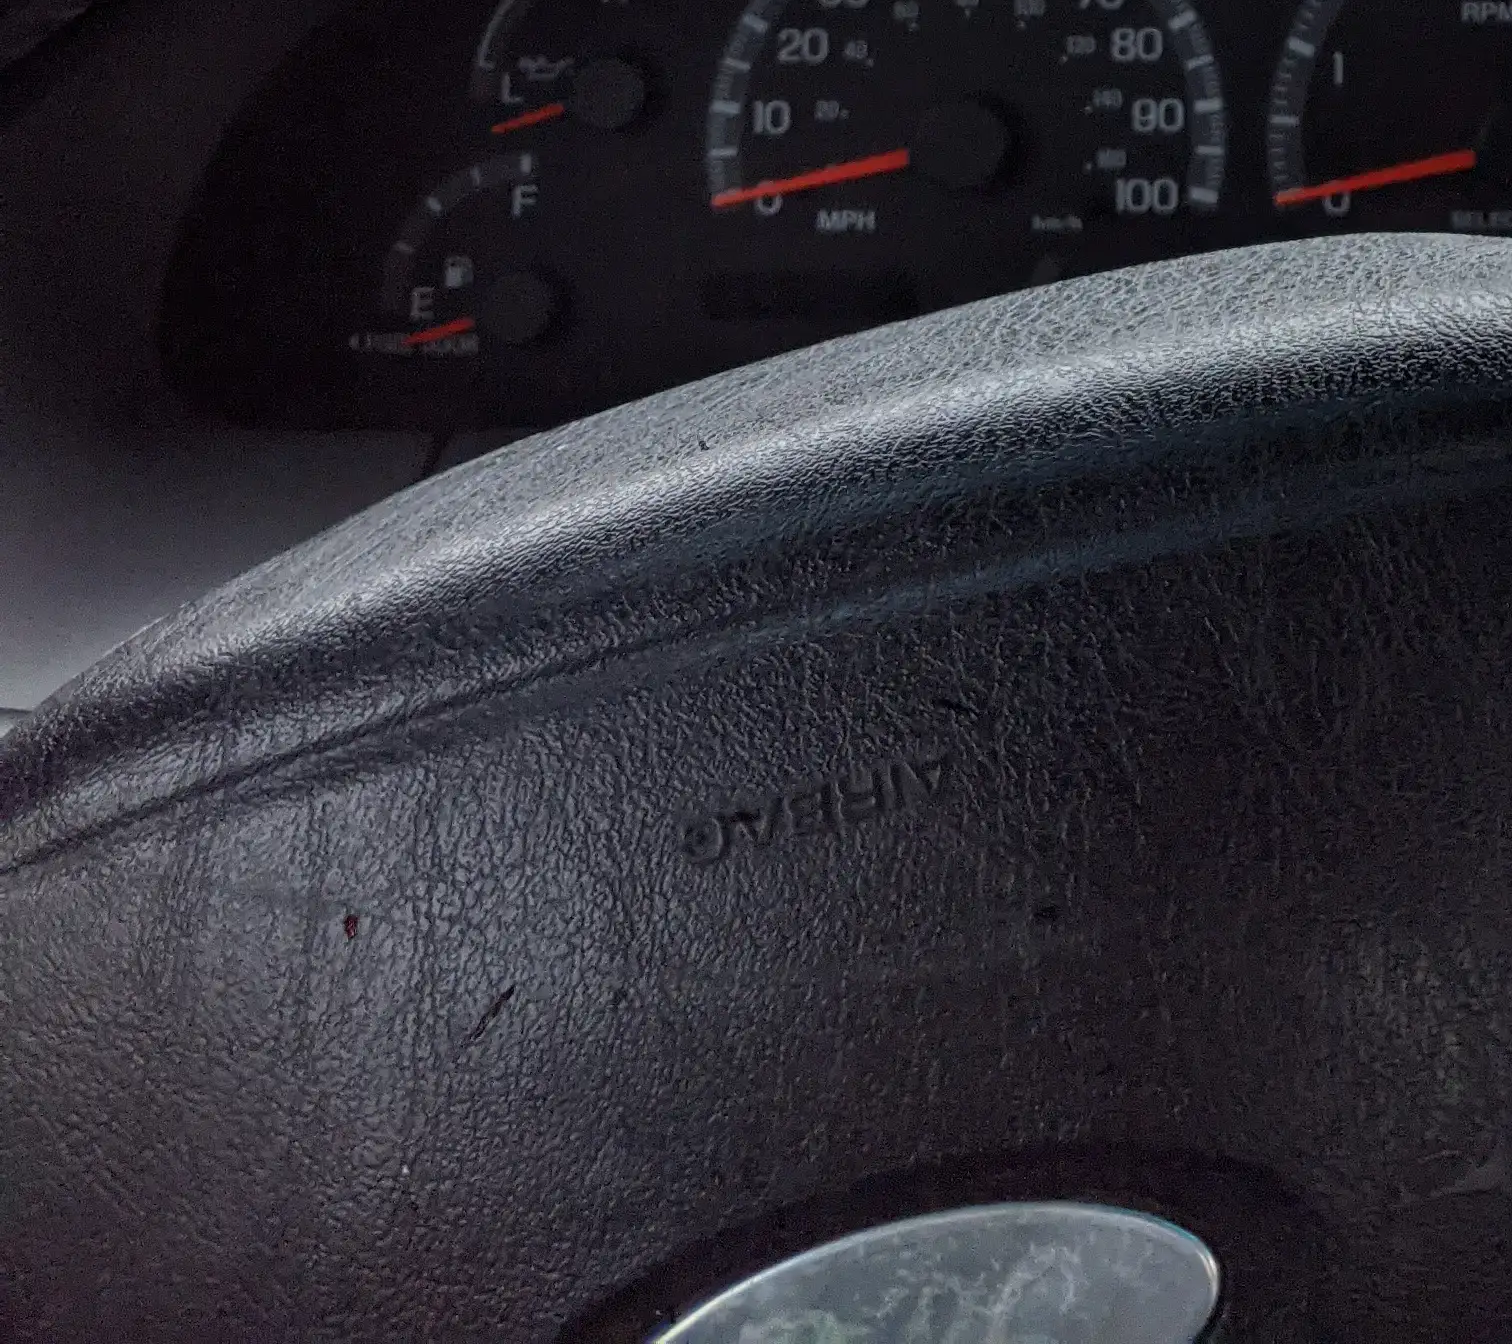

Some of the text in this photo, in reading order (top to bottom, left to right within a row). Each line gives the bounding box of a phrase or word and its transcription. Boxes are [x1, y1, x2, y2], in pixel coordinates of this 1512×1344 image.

[777, 28, 829, 63] 20
[1111, 27, 1163, 62] 80
[1332, 51, 1344, 85] 1
[501, 72, 523, 104] L
[754, 100, 791, 135] 10
[1132, 98, 1184, 132] 90
[512, 184, 538, 216] F
[1116, 178, 1178, 212] 100
[816, 209, 876, 231] MPH
[410, 286, 434, 320] E
